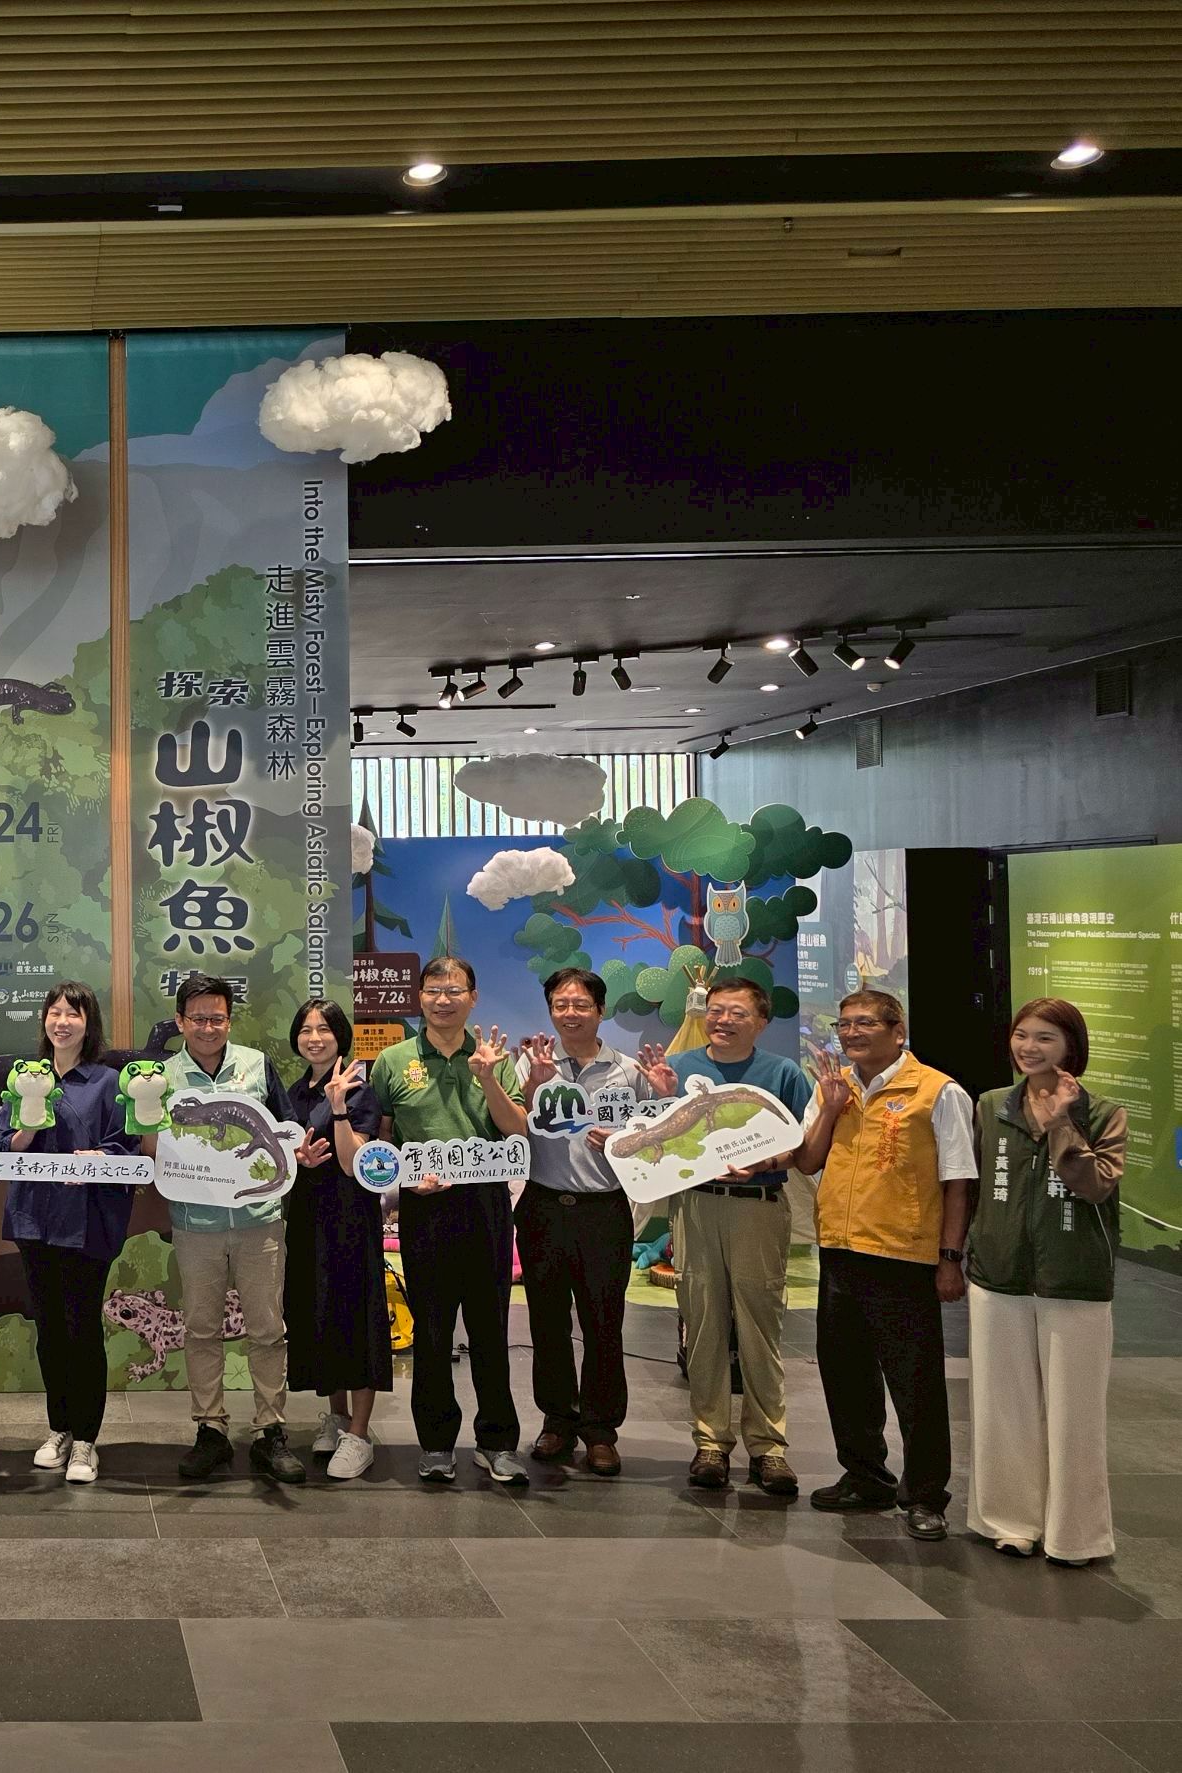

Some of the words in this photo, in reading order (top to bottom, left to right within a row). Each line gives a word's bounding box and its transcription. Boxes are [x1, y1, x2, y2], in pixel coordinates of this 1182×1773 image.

[304, 480, 323, 521] Into
[304, 527, 324, 561] the
[301, 568, 325, 624] Misty
[265, 564, 297, 781] 走進雲霧森林
[157, 671, 249, 705] 探索
[302, 718, 326, 818] Exploring
[47, 821, 59, 843] FRI
[147, 720, 255, 954] 山椒魚
[306, 824, 327, 896] Asiatic
[47, 913, 59, 943] SUN
[353, 967, 400, 982] 椒魚
[378, 991, 406, 1004] 7.26
[599, 1092, 630, 1102] 內政部
[405, 1141, 525, 1172] 雪霸國家公園
[720, 1146, 752, 1161] Hynobius
[753, 1136, 776, 1150] sonani
[11, 1157, 149, 1178] 臺南市政府文化局
[163, 1170, 195, 1180] Hynobius
[164, 1160, 211, 1173] 阿里山山椒魚
[448, 1169, 498, 1180] NATIONAL
[500, 1167, 525, 1176] PARK
